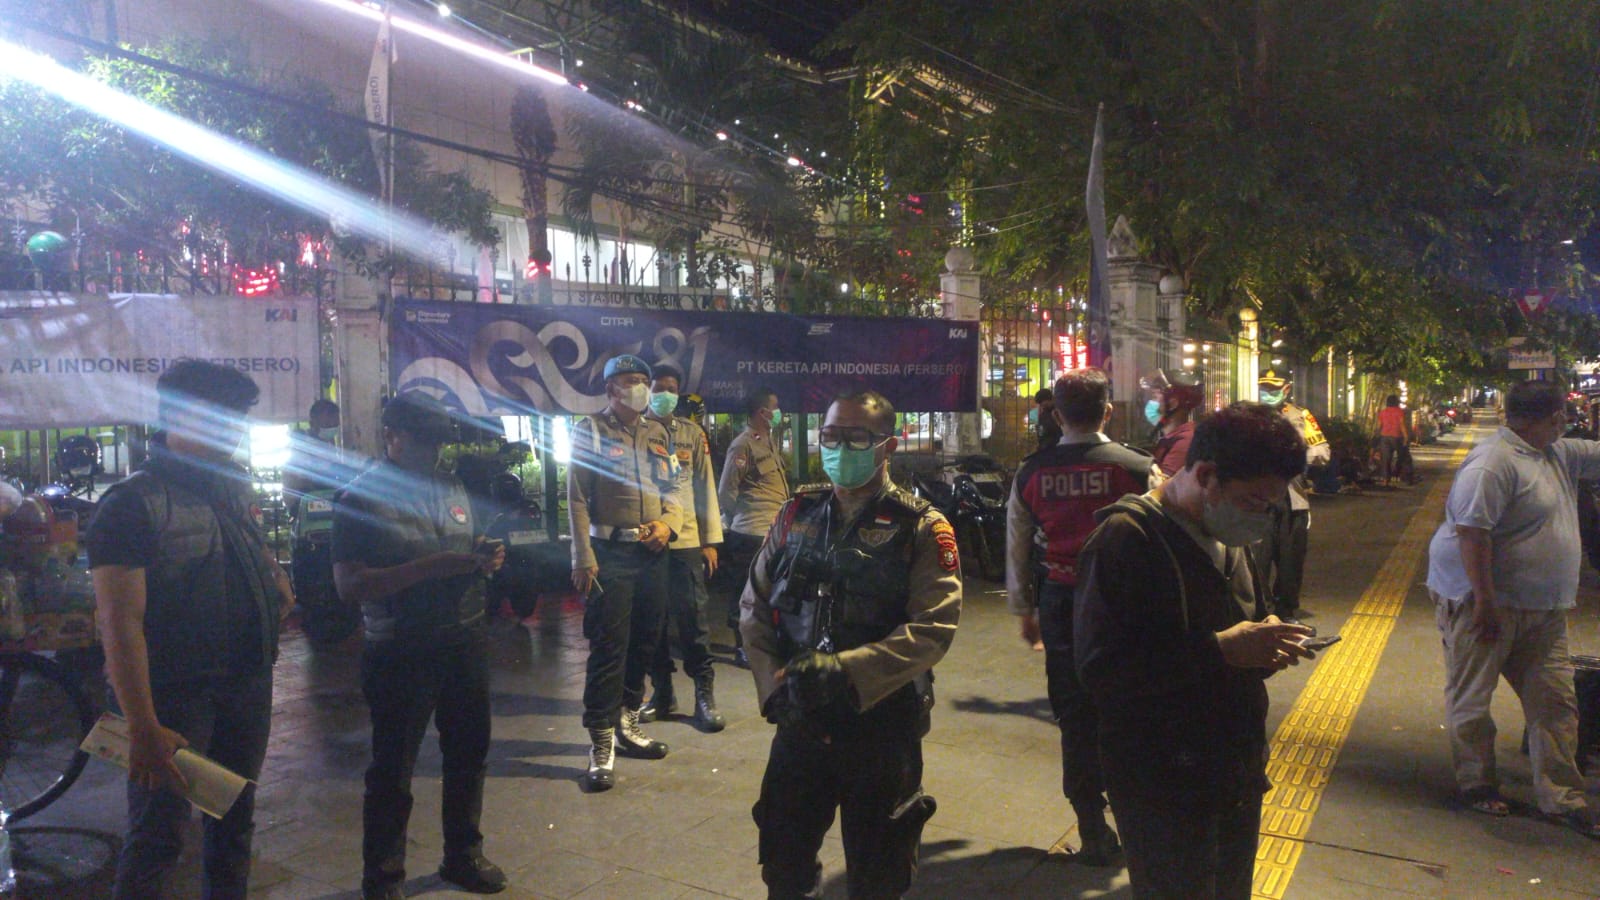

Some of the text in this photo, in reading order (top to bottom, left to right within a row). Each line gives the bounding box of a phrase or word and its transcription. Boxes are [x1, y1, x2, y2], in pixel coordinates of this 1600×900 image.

[265, 308, 298, 322] KAI
[949, 328, 967, 339] KAI
[10, 358, 49, 373] API
[58, 357, 176, 373] INDONESI
[736, 361, 754, 374] PT
[757, 361, 809, 374] KERETA
[811, 362, 832, 374] API
[835, 363, 901, 375] INDONESIA
[1042, 471, 1109, 497] POLISI
